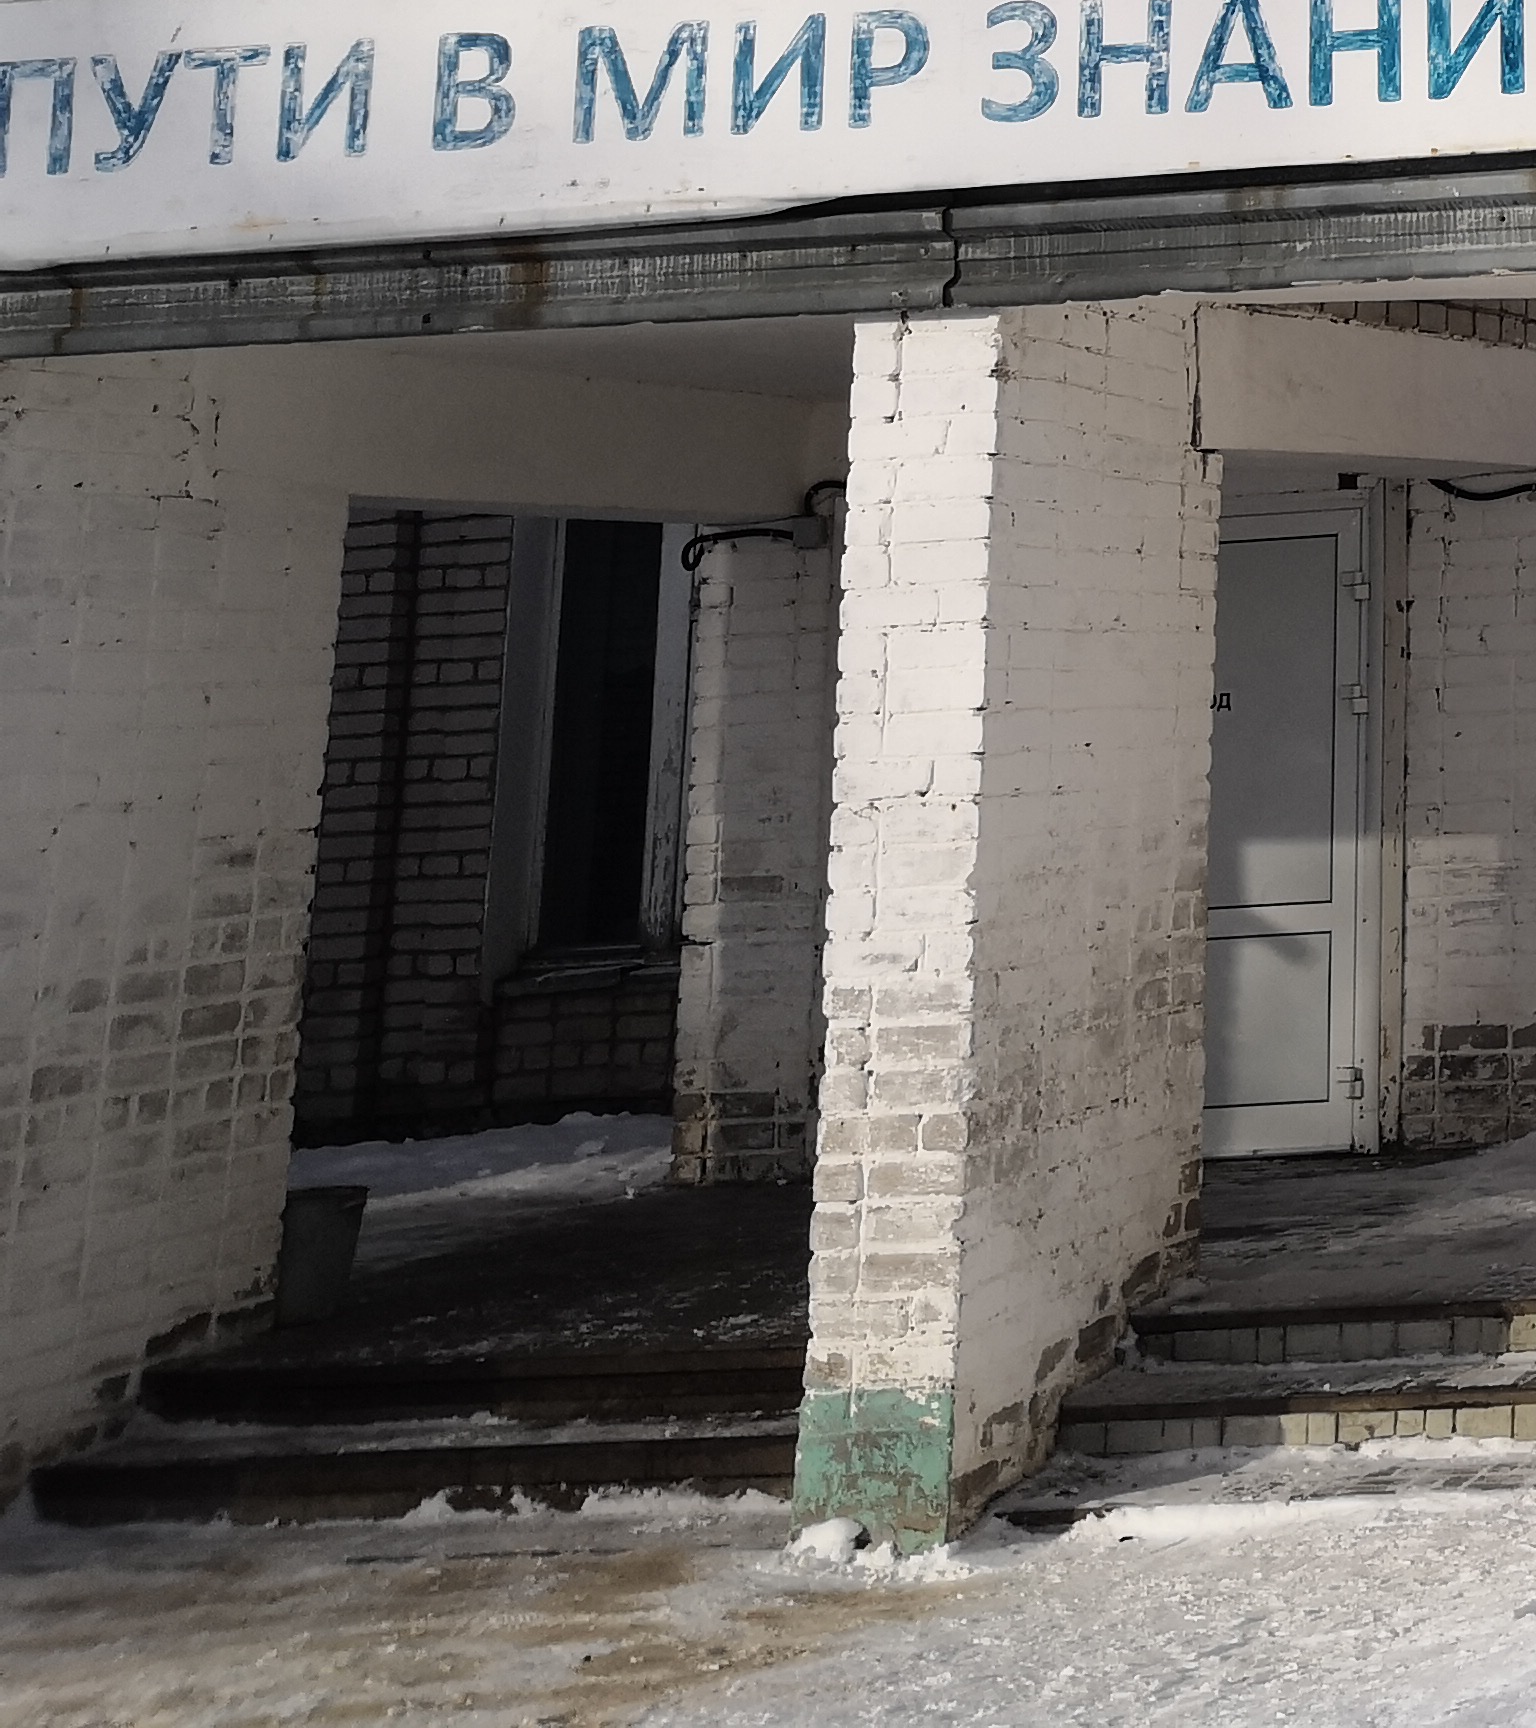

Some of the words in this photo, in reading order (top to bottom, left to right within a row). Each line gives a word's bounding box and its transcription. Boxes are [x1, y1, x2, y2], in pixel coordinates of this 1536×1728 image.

[0, 38, 376, 175] ПУТИ
[432, 31, 517, 152] В
[572, 9, 931, 145] МИР
